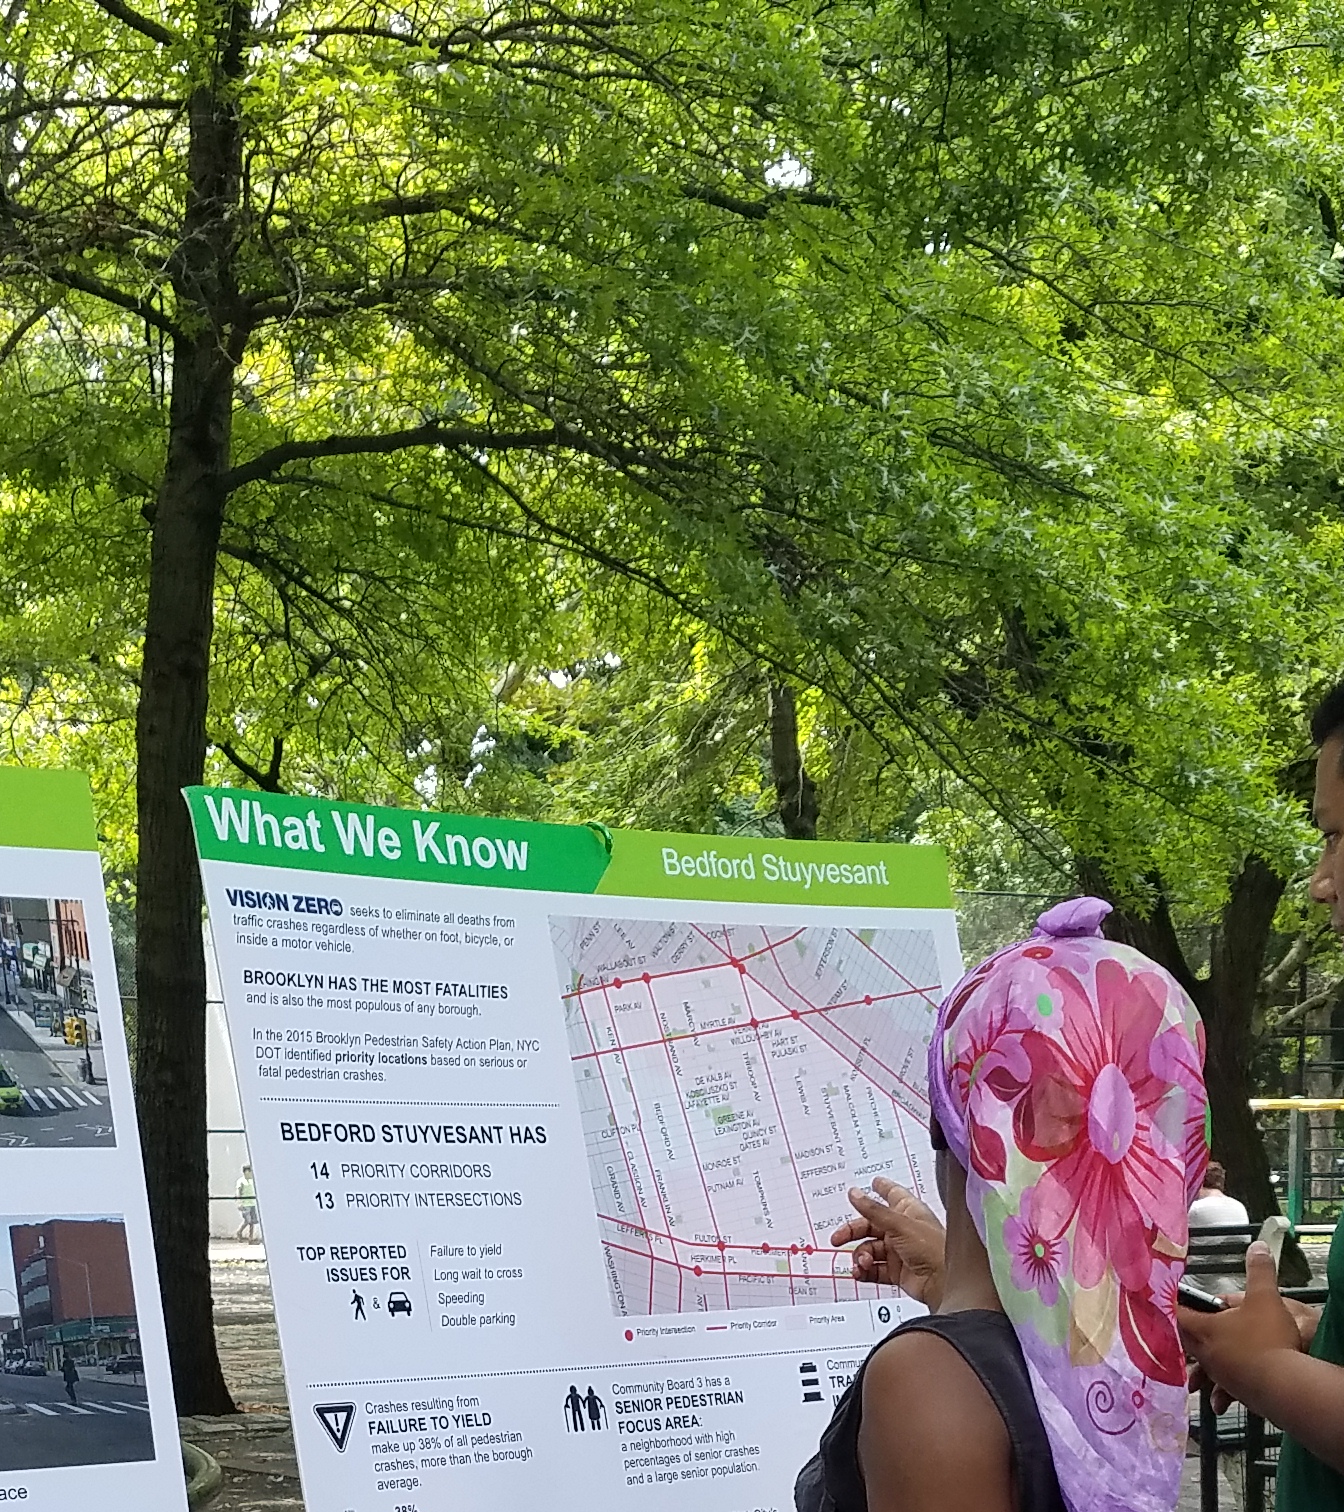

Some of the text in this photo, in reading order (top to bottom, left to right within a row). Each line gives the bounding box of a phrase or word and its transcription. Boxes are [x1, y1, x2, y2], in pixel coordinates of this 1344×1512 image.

[204, 795, 528, 870] What We Know
[662, 848, 889, 889] Bedford Stuyvesant
[225, 888, 343, 916] VISION ZERO
[350, 906, 514, 927] seeks to eliminate all deaths from
[233, 914, 514, 947] traffic crashes regardless of whether on foot, bicycle, or
[236, 934, 354, 952] inside a motor vehicle.
[244, 970, 507, 998] BROOKLYN HAS THE MOST FATALITIES
[633, 1002, 642, 1010] AV
[727, 1017, 736, 1025] AV
[253, 1028, 539, 1051] In the 2015 Brooklyn Pedestrian Safety Action Plan, NYC
[256, 1046, 527, 1067] DOT identified priority locations based on serious or
[259, 1064, 386, 1081] fatal pedestrian crashes.
[280, 1122, 546, 1143] BEDFORD STUYVESANT HAS
[826, 1144, 834, 1153] ST
[732, 1155, 741, 1165] ST
[885, 1160, 894, 1170] ST
[310, 1162, 491, 1179] 14 PRIORITY CORRIDORS
[838, 1183, 846, 1192] ST
[315, 1192, 521, 1209] 13 PRIORITY INTERSECTIONS
[296, 1245, 406, 1260] TOP REPORTED
[430, 1244, 501, 1258] Failure to yield
[326, 1266, 411, 1282] ISSUES FOR
[434, 1268, 522, 1282] Long wait to cross
[373, 1297, 381, 1310] &
[438, 1292, 484, 1306] Speeding
[442, 1313, 515, 1327] Double parking
[612, 1376, 730, 1394] Community Board 3 has a
[365, 1396, 479, 1414] Crashes resulting from
[615, 1391, 743, 1414] SENIOR PEDESTRIAN
[368, 1412, 491, 1435] FAILURE TO YIELD
[618, 1414, 702, 1434] FOCUS AREA:
[371, 1430, 522, 1454] make up 38% of all pedestrian
[374, 1447, 532, 1472] crashes, more than the borough
[377, 1478, 421, 1490] average.
